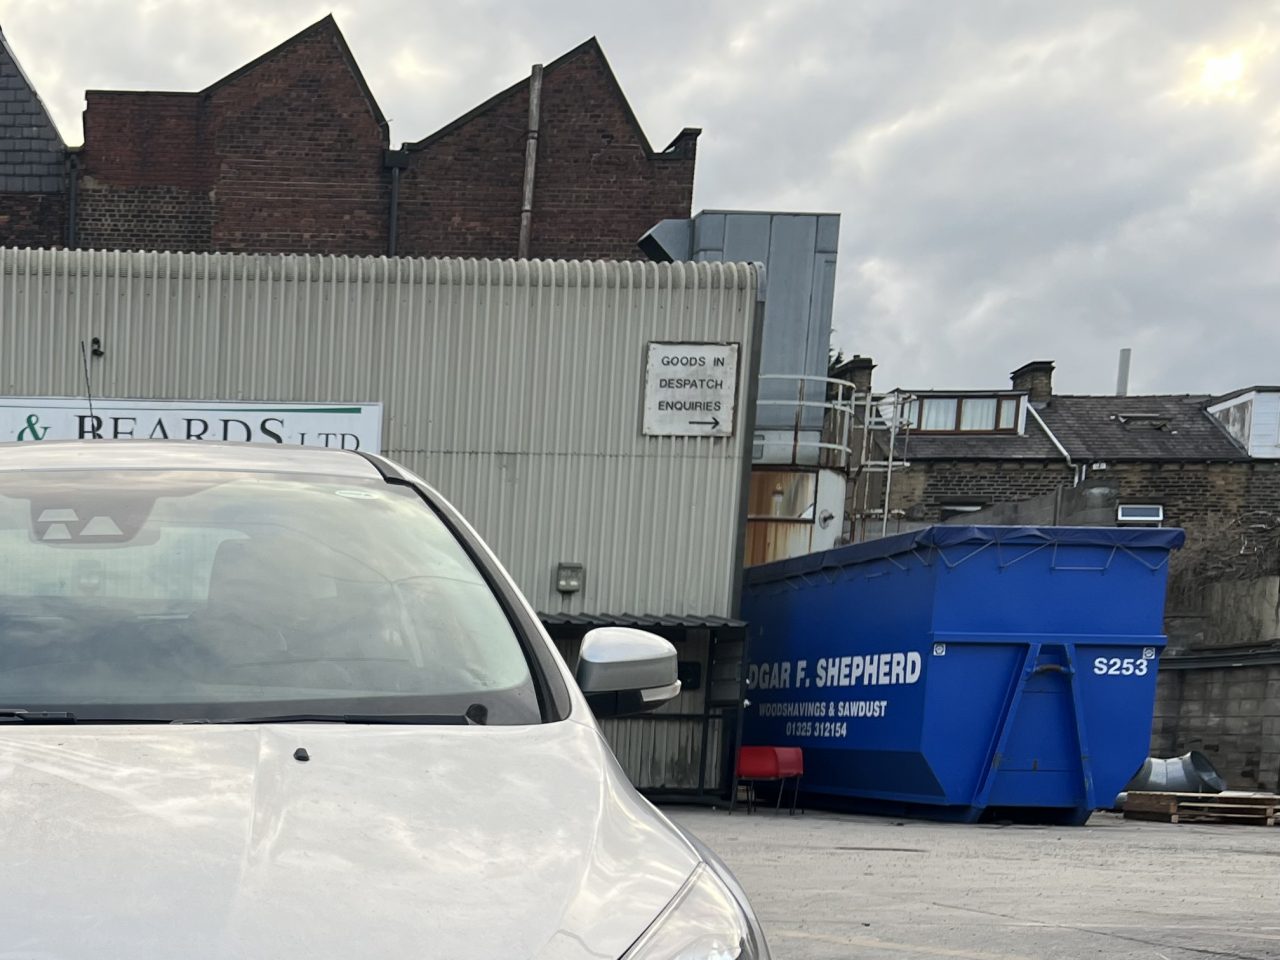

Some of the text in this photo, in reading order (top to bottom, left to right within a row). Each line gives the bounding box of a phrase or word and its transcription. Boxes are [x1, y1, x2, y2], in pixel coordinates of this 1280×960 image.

[661, 356, 725, 367] GOODS IN
[659, 378, 723, 390] DESPATCH
[658, 400, 721, 412] ENQUIRIES
[16, 413, 51, 442] &
[747, 650, 922, 690] DGAR F. SHEPHERD
[1093, 657, 1148, 676] S253
[758, 700, 888, 718] WOODSHAVINGS & SAWDUST
[786, 721, 847, 738] 01325 312154
